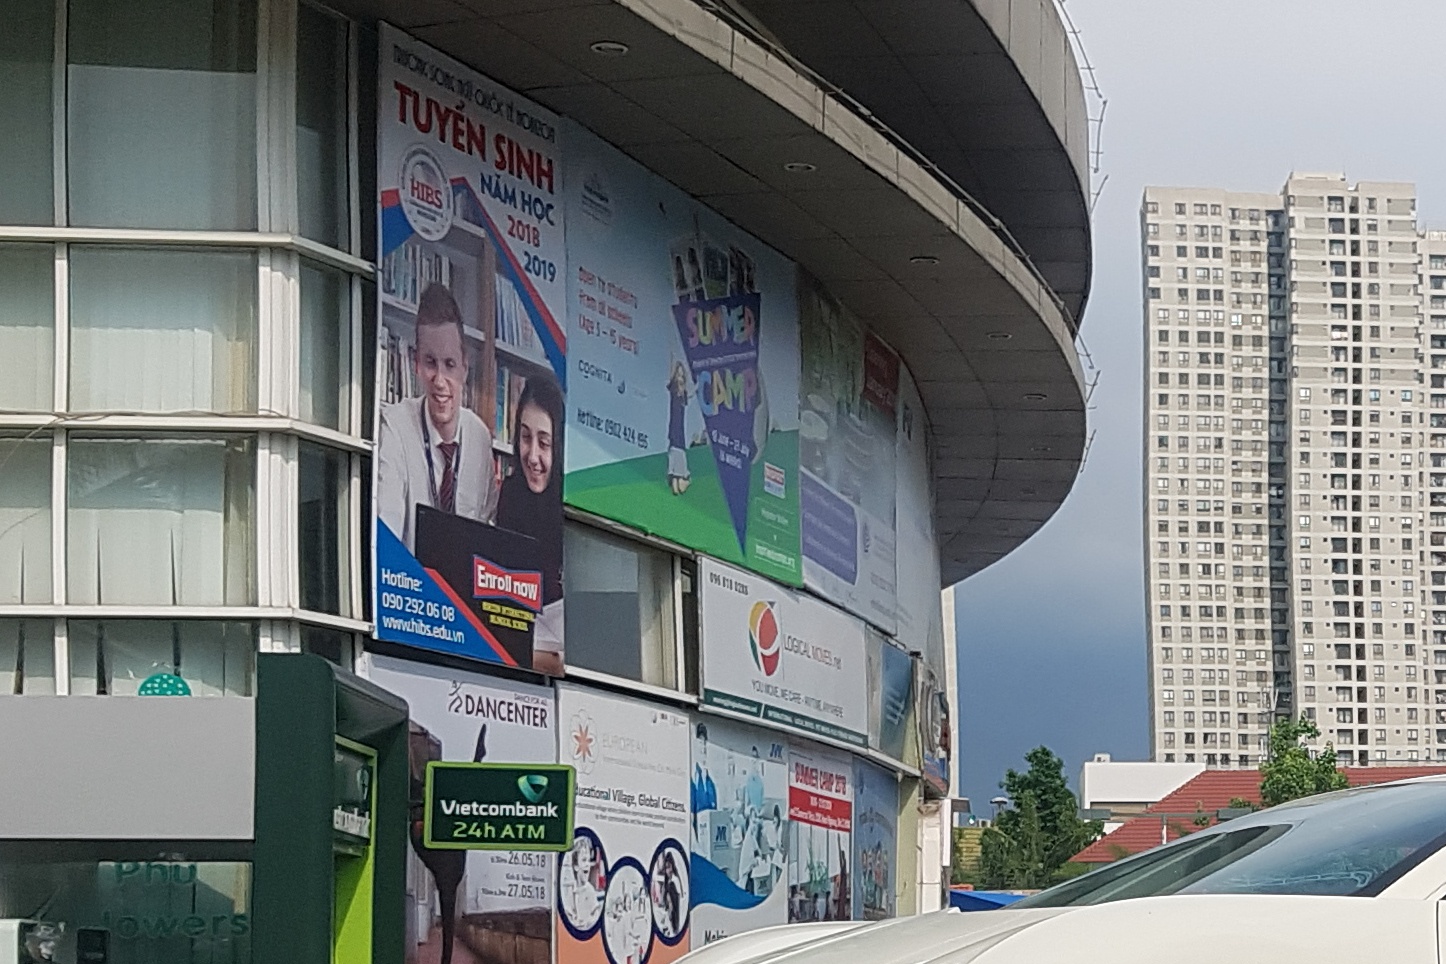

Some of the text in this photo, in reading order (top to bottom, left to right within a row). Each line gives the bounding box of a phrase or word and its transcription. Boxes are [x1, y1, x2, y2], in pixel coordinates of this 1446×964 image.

[394, 80, 486, 162] TUYỂN
[493, 133, 554, 195] SINH
[410, 177, 443, 209] HIBS
[480, 172, 517, 210] NĂM
[520, 190, 555, 226] HỌC
[507, 215, 540, 248] 2018
[523, 250, 557, 283] 2019
[686, 304, 755, 348] SUMMER
[579, 360, 612, 383] COGNITA
[697, 368, 757, 416] CAMP
[381, 567, 423, 592] Hotline:
[477, 564, 538, 601] Enroll now
[382, 592, 455, 622] 090 292 06 08
[382, 615, 465, 644] www.hibs.edu.vn
[465, 694, 547, 728] DANCENTER
[440, 800, 558, 818] Vietcombank
[452, 822, 545, 840] 24h ATM
[508, 852, 546, 867] 26.05.18
[508, 884, 545, 899] 27.05.18
